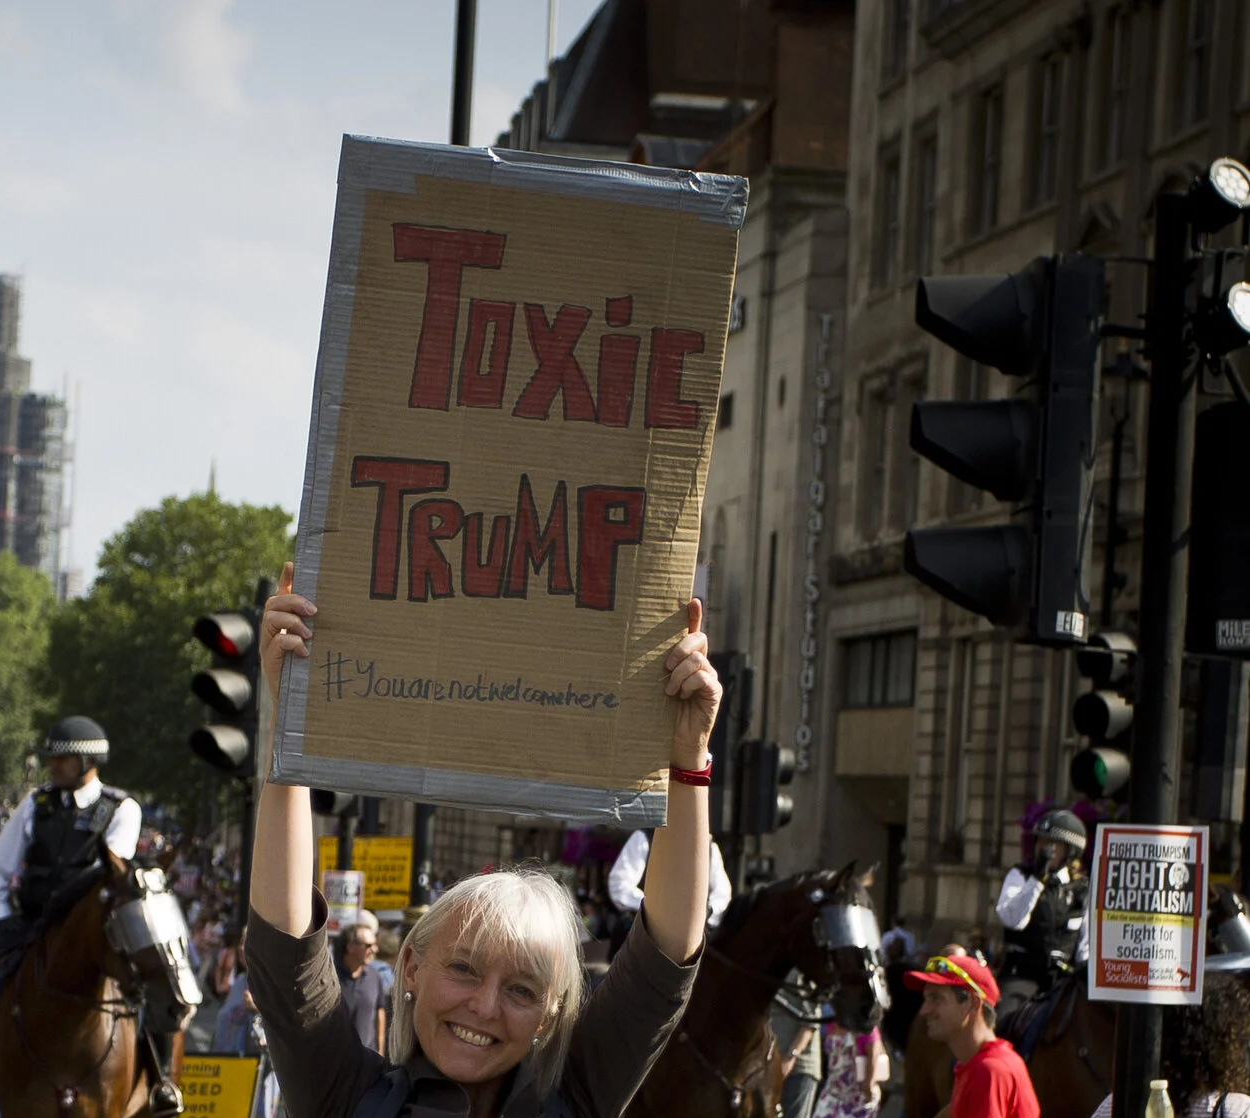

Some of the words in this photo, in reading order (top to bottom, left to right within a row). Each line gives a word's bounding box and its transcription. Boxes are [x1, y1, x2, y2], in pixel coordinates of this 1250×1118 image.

[1108, 842, 1138, 858] FIGHT
[1141, 844, 1191, 860] TRUMPISM
[1106, 860, 1168, 890] FIGHT
[1104, 887, 1194, 913] CAPITALISM
[1123, 923, 1156, 944] Fight
[1159, 926, 1174, 941] for
[1103, 960, 1131, 974] Young
[1105, 971, 1148, 985] Socialists
